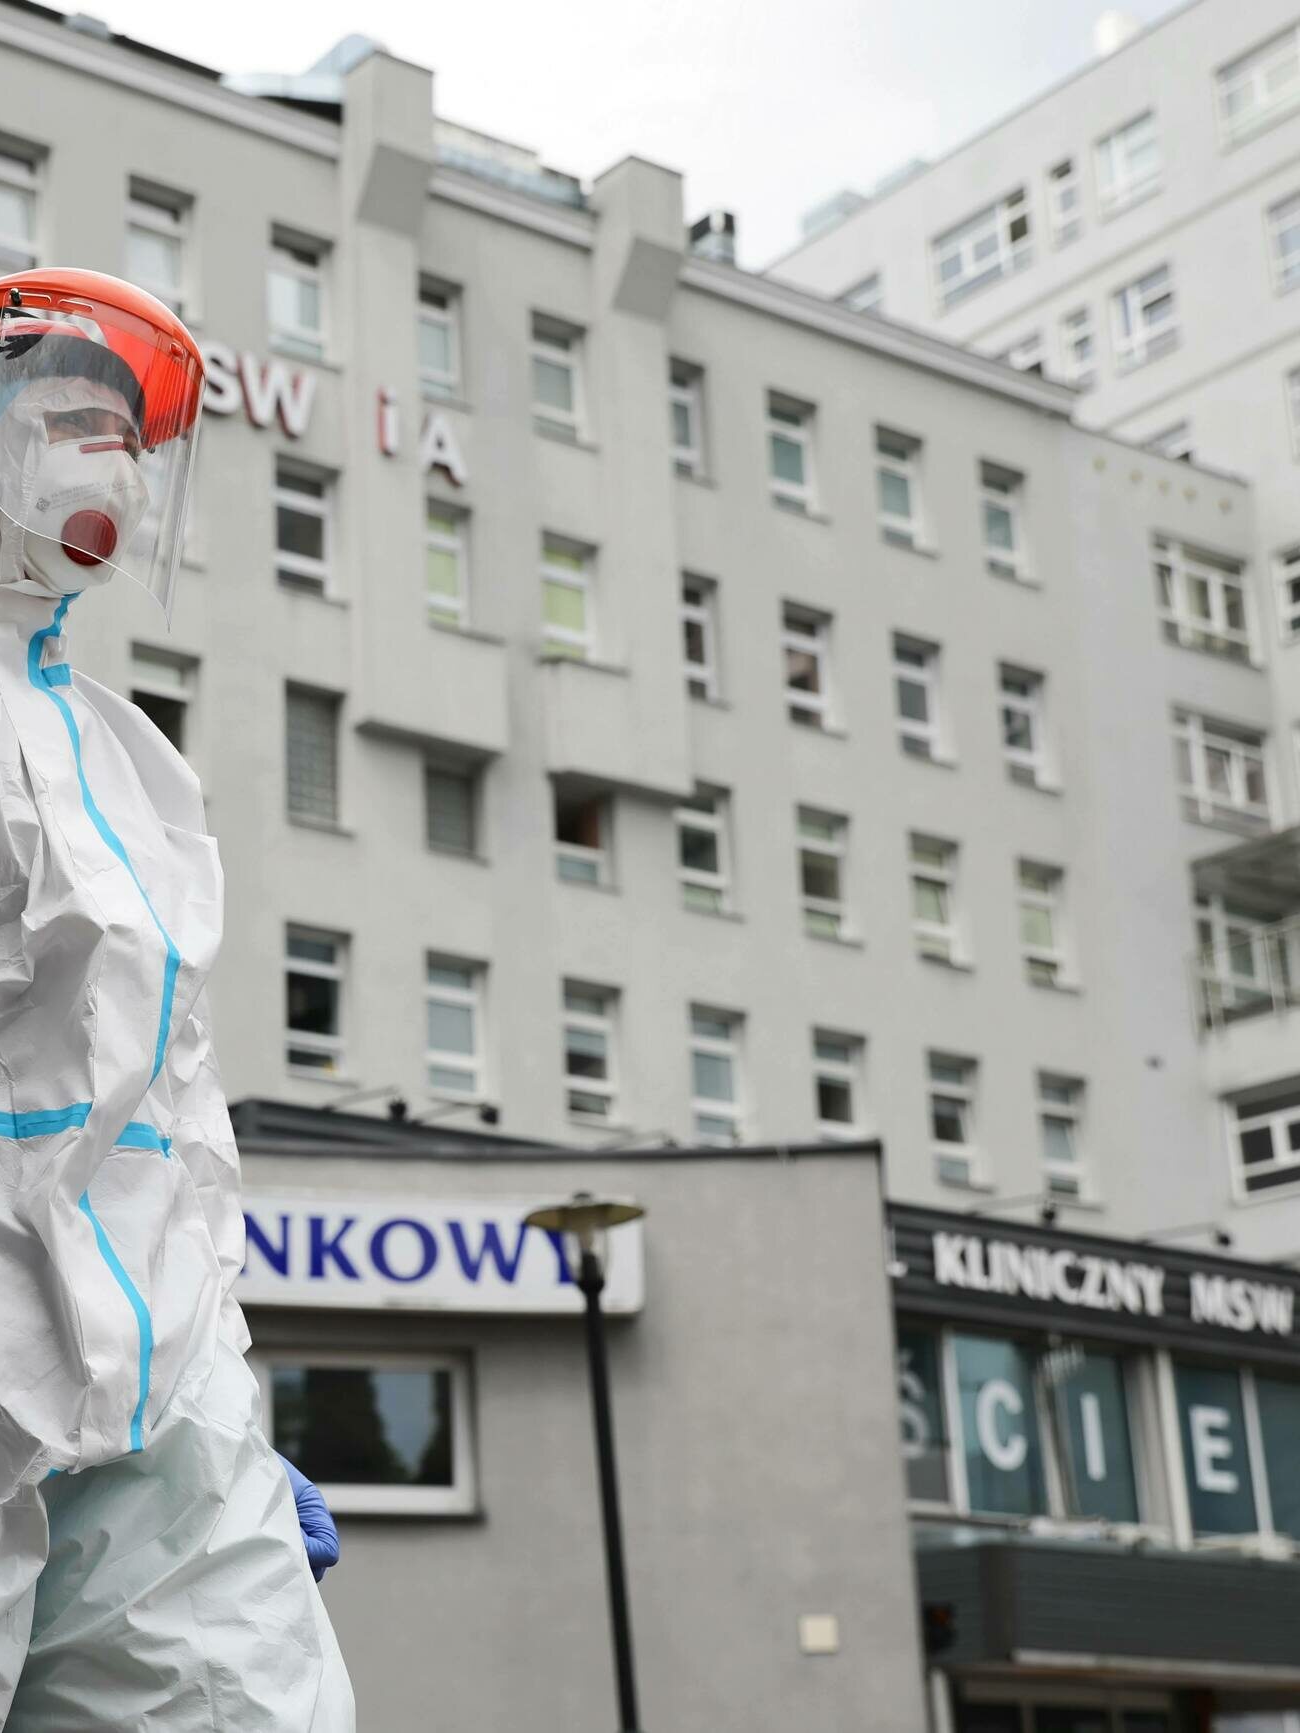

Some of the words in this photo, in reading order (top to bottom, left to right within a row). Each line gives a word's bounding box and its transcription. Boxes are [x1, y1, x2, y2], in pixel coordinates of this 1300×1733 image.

[419, 411, 468, 488] A
[932, 1230, 1164, 1317] KLINICZNY
[1190, 1271, 1294, 1335] MSW
